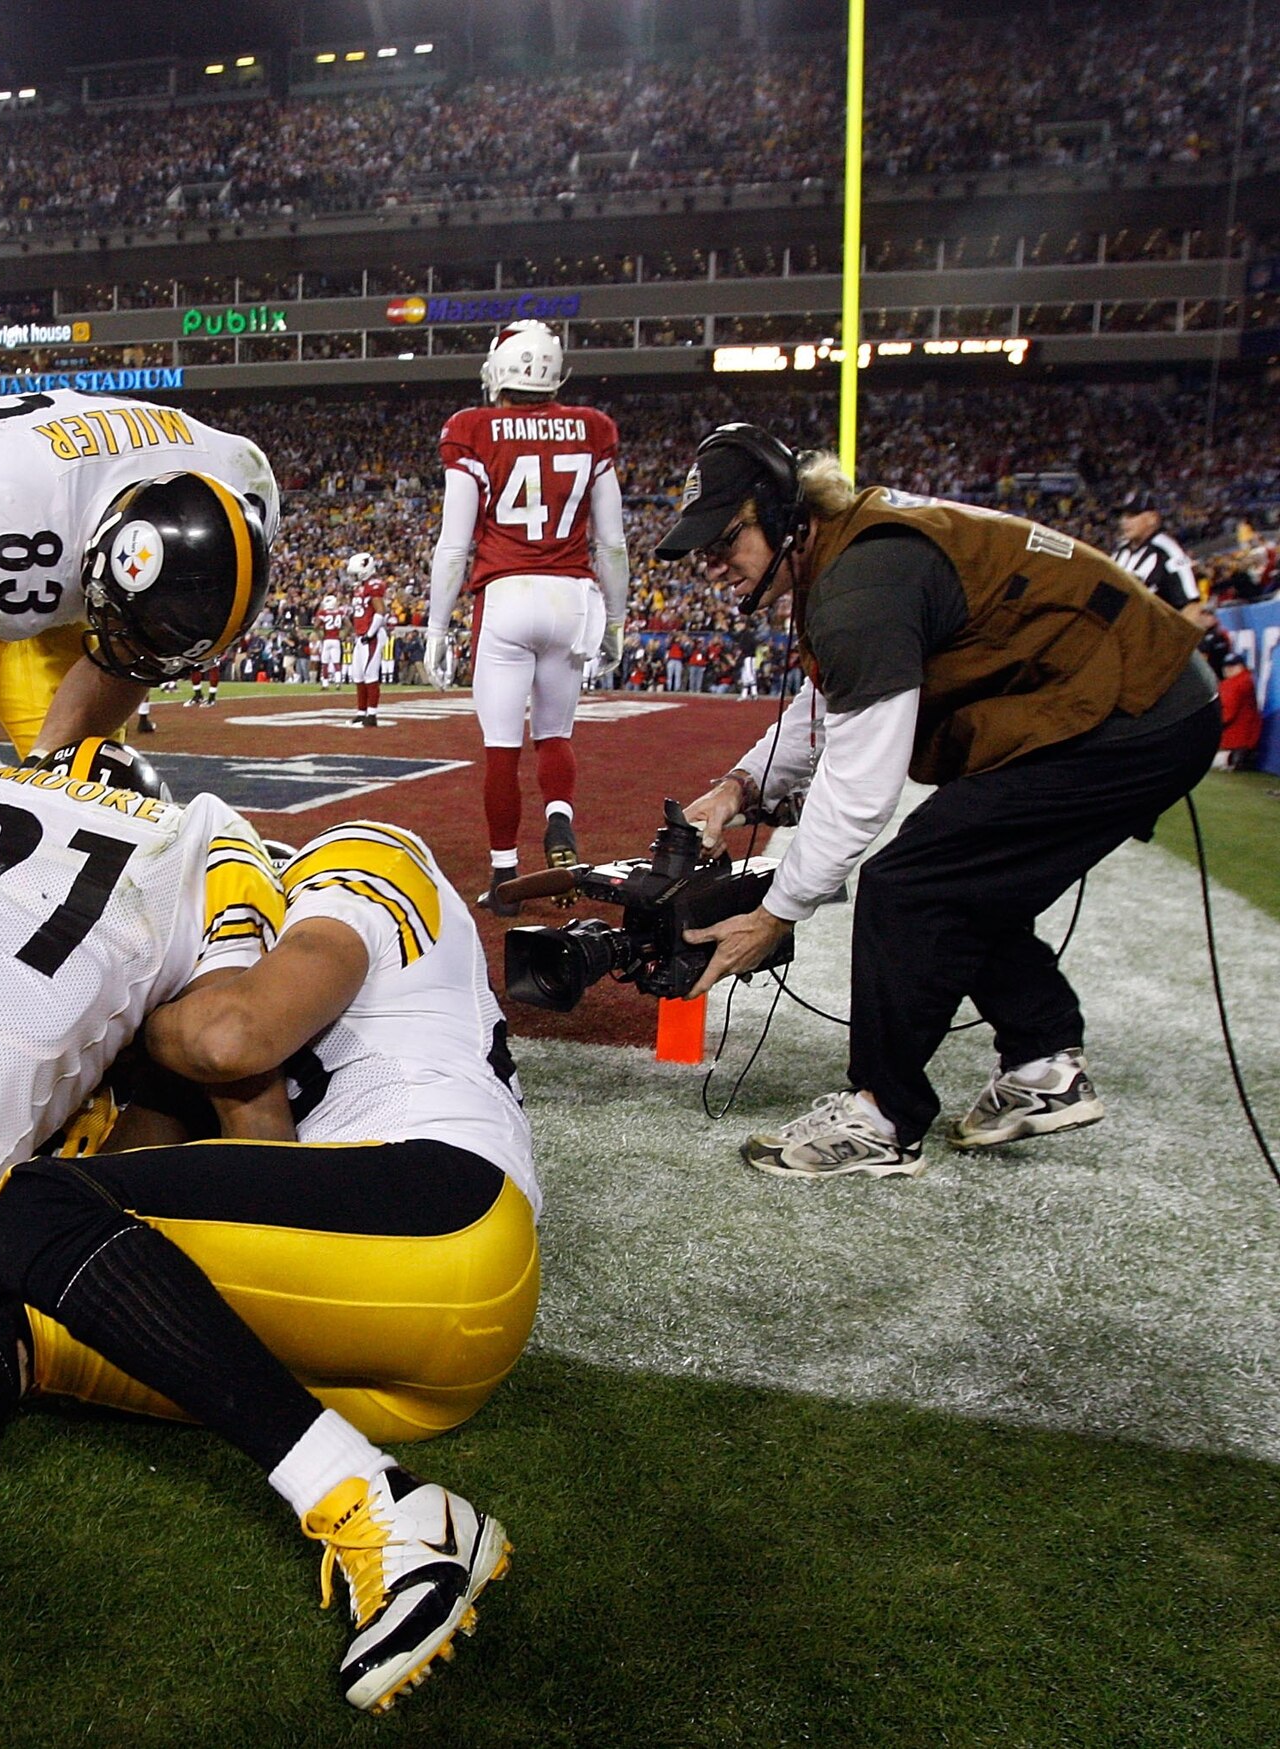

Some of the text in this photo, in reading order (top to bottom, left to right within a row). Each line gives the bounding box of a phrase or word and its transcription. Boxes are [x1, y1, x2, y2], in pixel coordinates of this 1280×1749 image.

[183, 306, 287, 335] Publix
[428, 293, 581, 322] MasterCard
[30, 322, 71, 343] house
[0, 373, 70, 395] JAMES
[74, 367, 185, 391] STADIUM
[32, 408, 195, 460] MILLER
[491, 418, 587, 442] FRANCISCO
[495, 452, 593, 541] 47
[324, 613, 343, 630] 24
[655, 878, 688, 905] NBC
